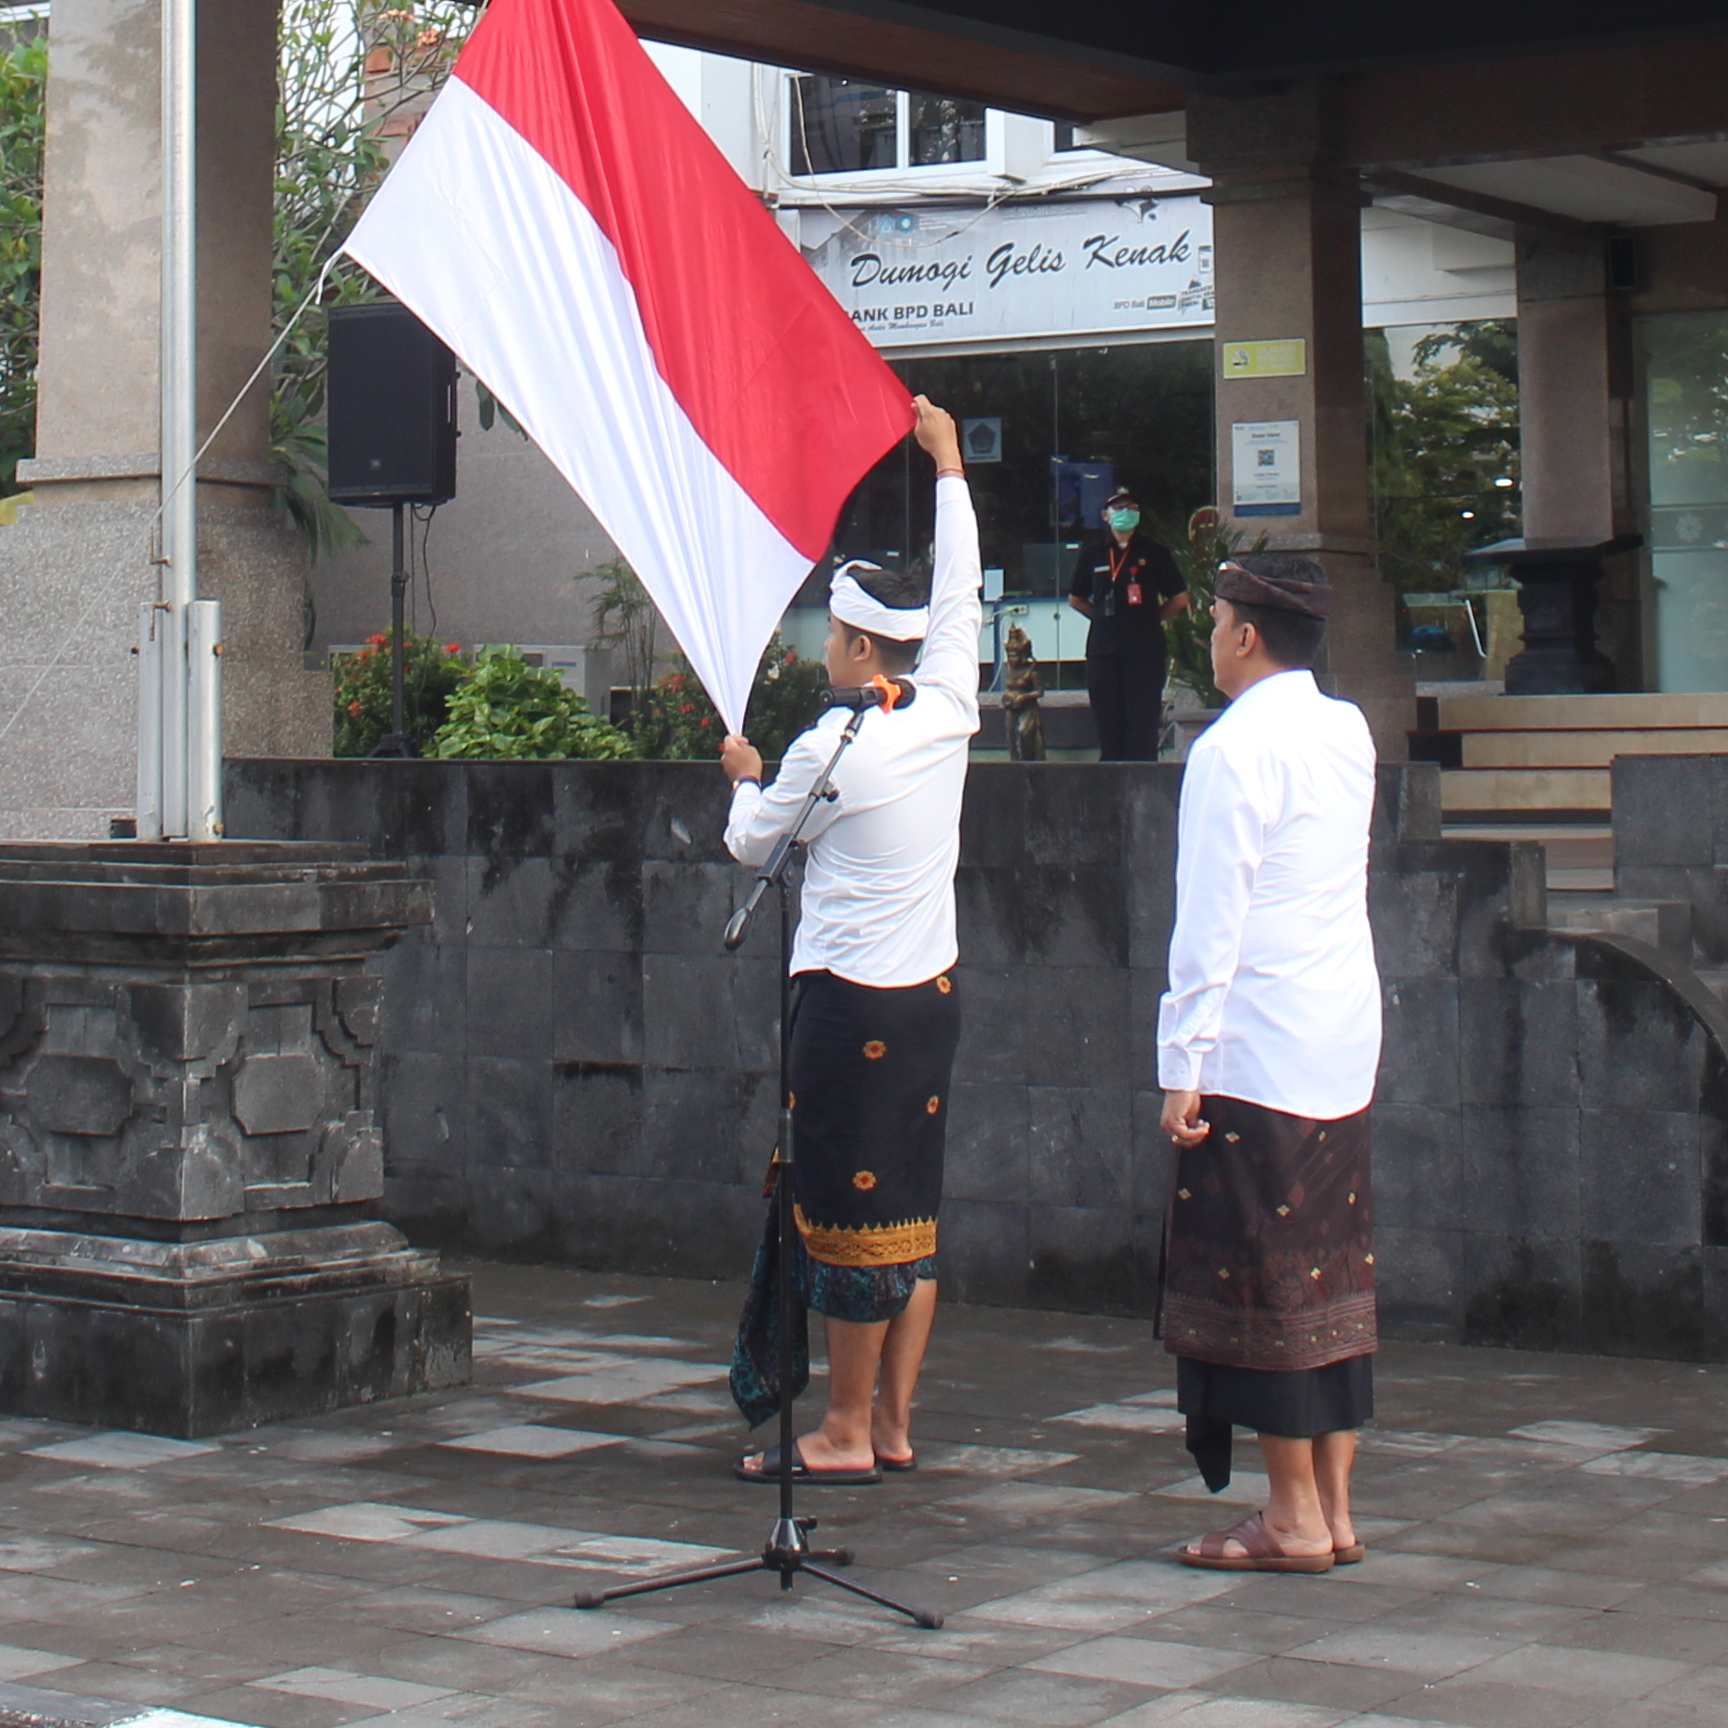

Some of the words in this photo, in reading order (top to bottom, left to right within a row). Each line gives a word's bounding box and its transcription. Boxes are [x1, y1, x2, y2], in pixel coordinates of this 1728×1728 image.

[851, 253, 972, 290] Dumogi
[986, 242, 1067, 288] Gelis
[1083, 229, 1192, 270] Kenak
[847, 308, 888, 321] ANK
[894, 305, 928, 320] BPD
[933, 302, 973, 316] BALI
